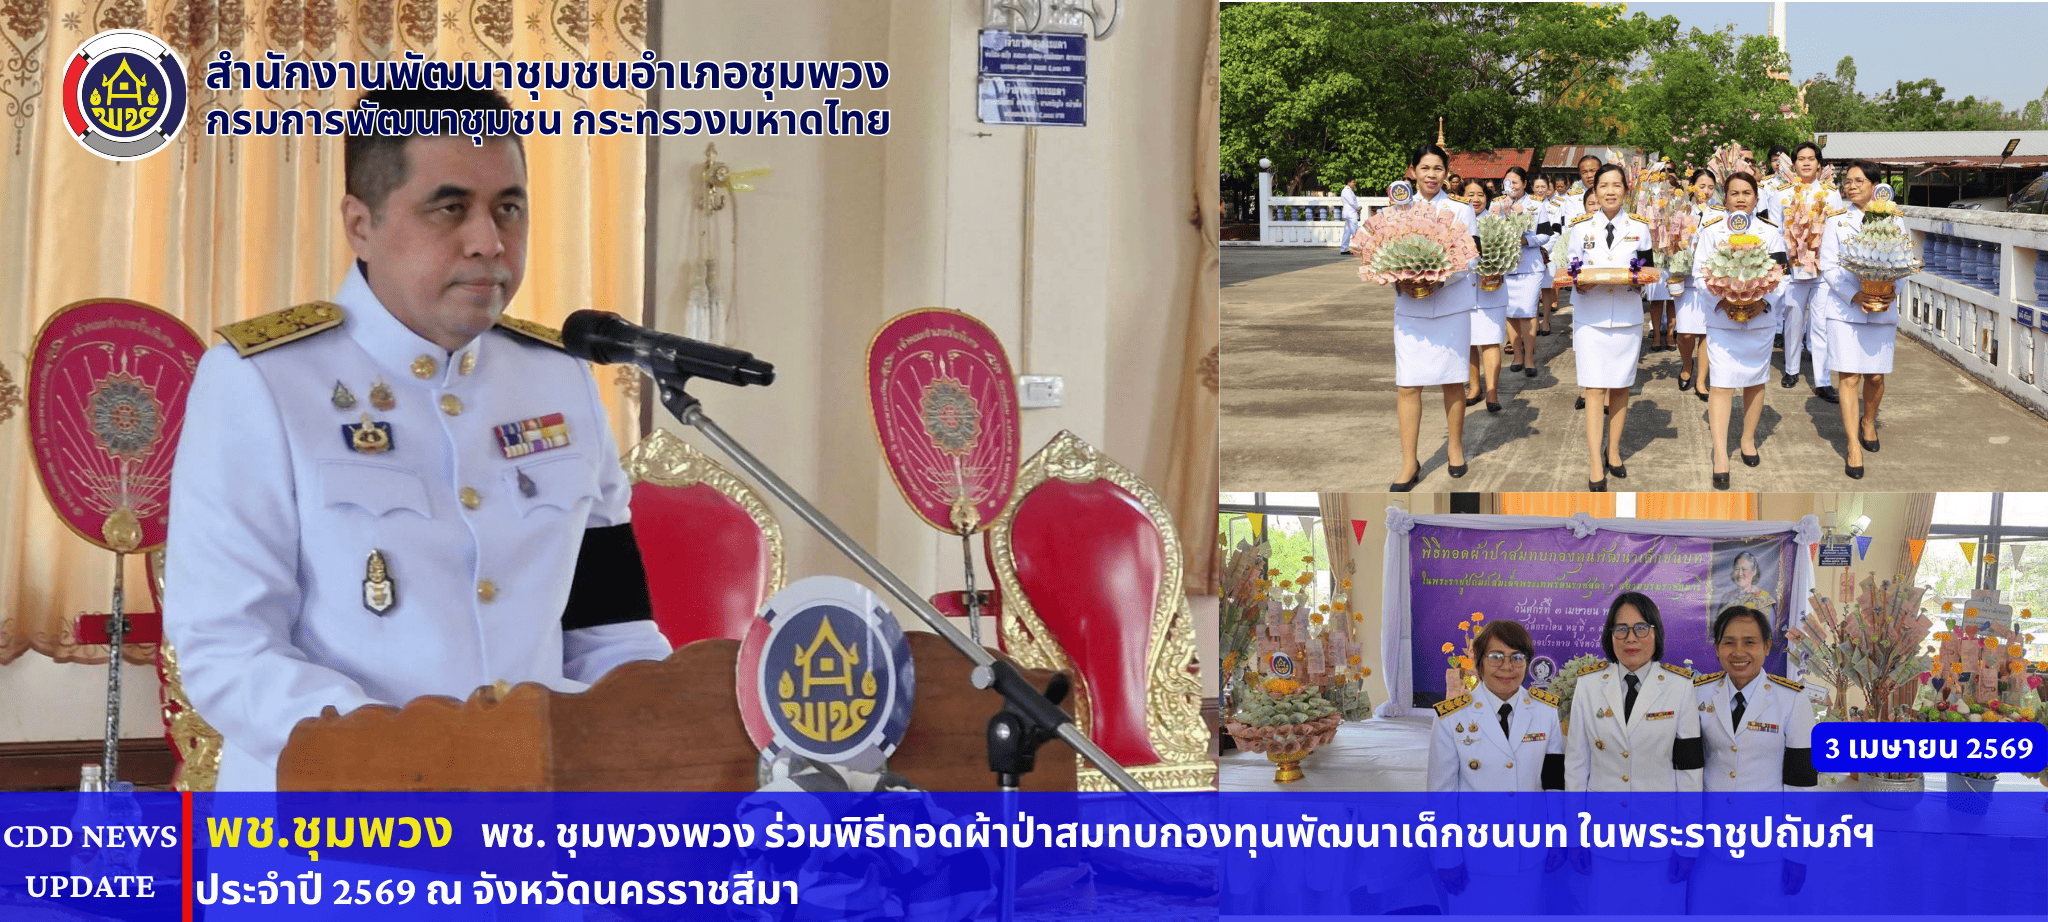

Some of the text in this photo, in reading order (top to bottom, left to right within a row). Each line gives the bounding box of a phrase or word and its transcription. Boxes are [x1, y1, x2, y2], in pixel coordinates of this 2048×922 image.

[1421, 536, 1704, 574] พิธีทอดผ้าป่าสมทบกองทุนพัฒนาเด็กชนบท
[1565, 607, 1599, 616] เมษายน
